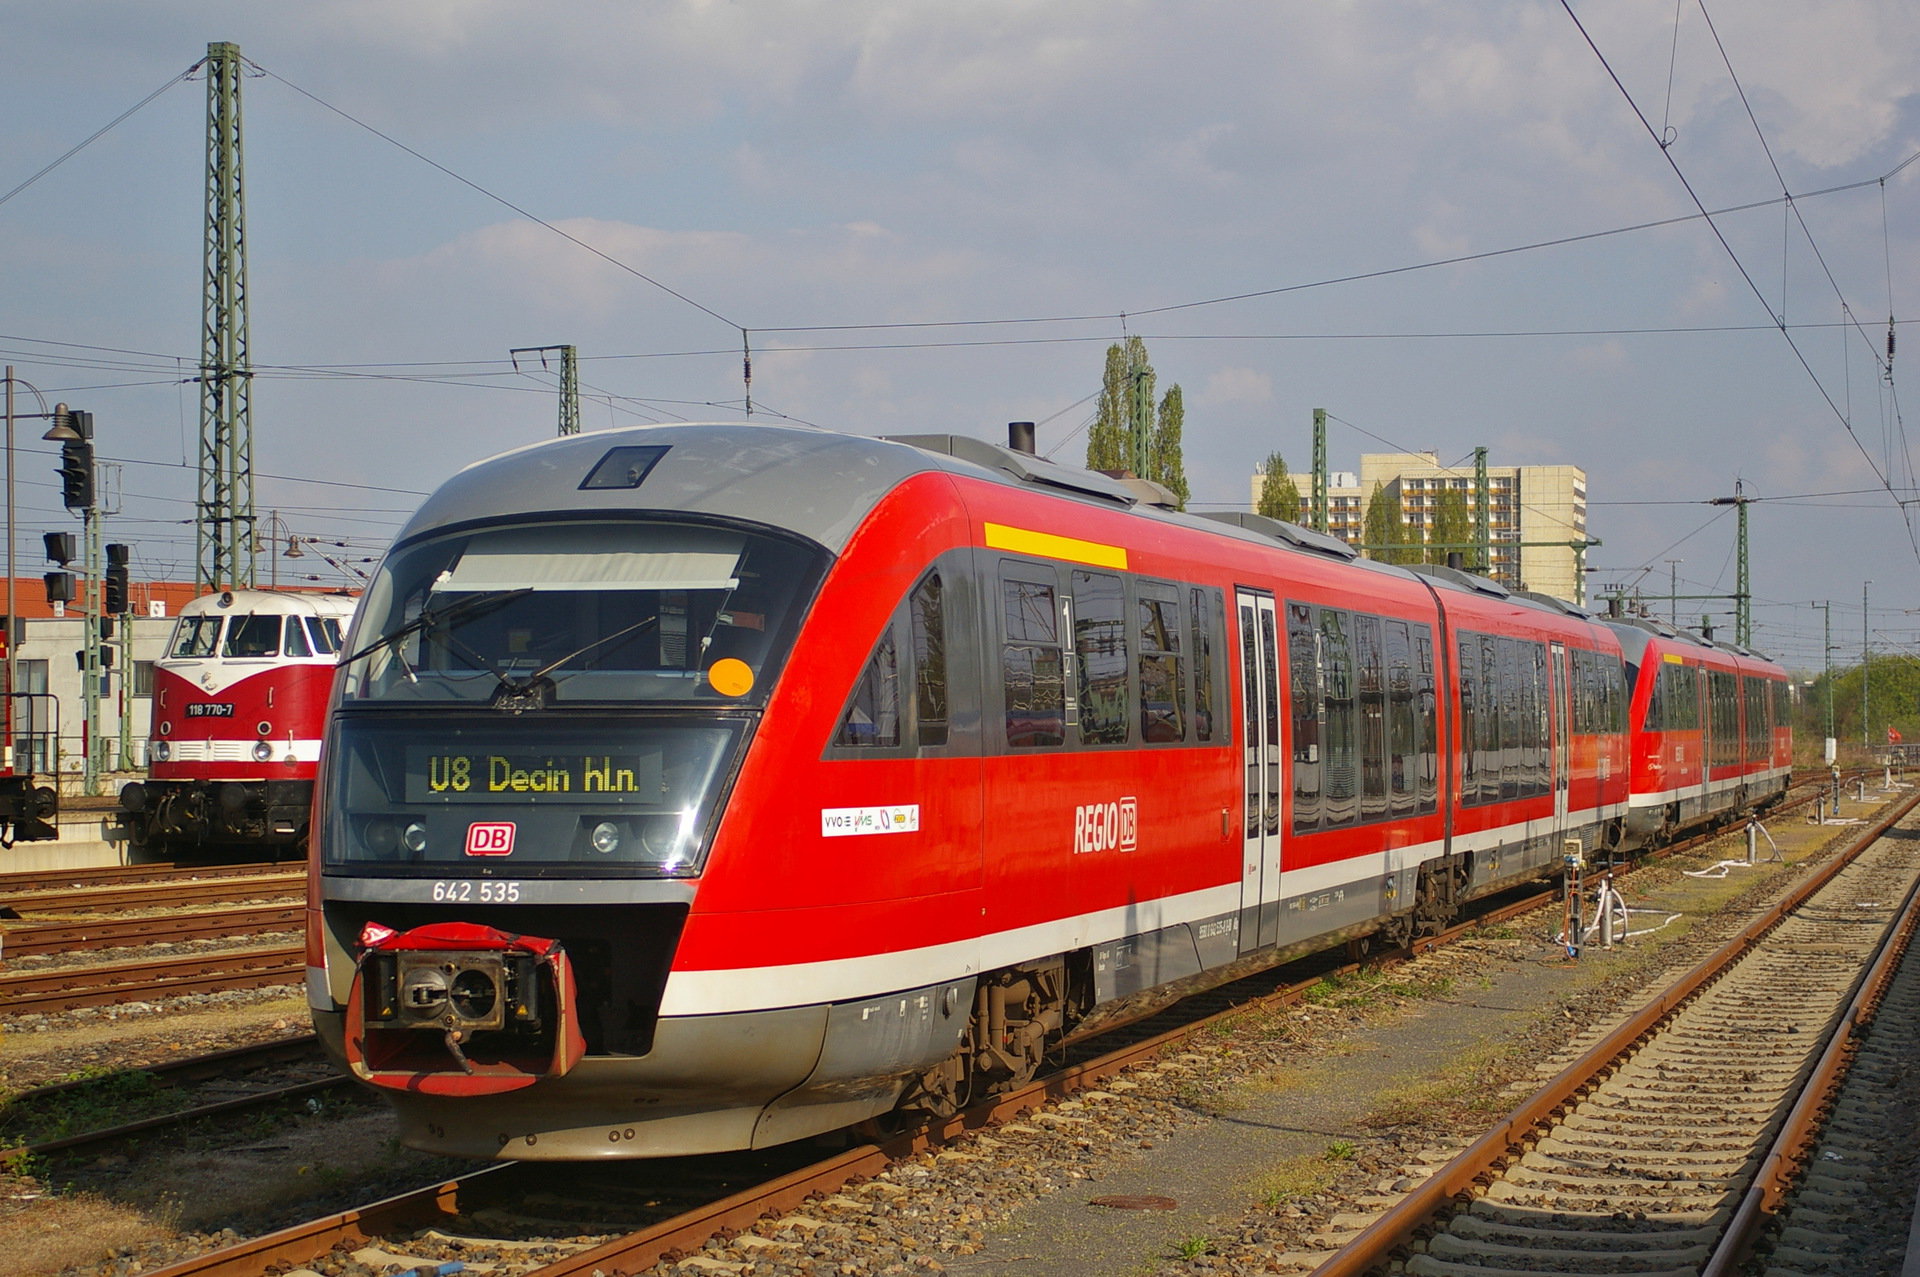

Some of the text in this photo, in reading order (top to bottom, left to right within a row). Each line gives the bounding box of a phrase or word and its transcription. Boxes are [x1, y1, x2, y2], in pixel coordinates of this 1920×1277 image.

[189, 704, 233, 715] 118 770-7
[430, 756, 471, 792] U8
[489, 756, 570, 792] Decin
[470, 825, 511, 852] DB
[1073, 802, 1136, 854] REGIO DB
[433, 882, 520, 902] 642 535
